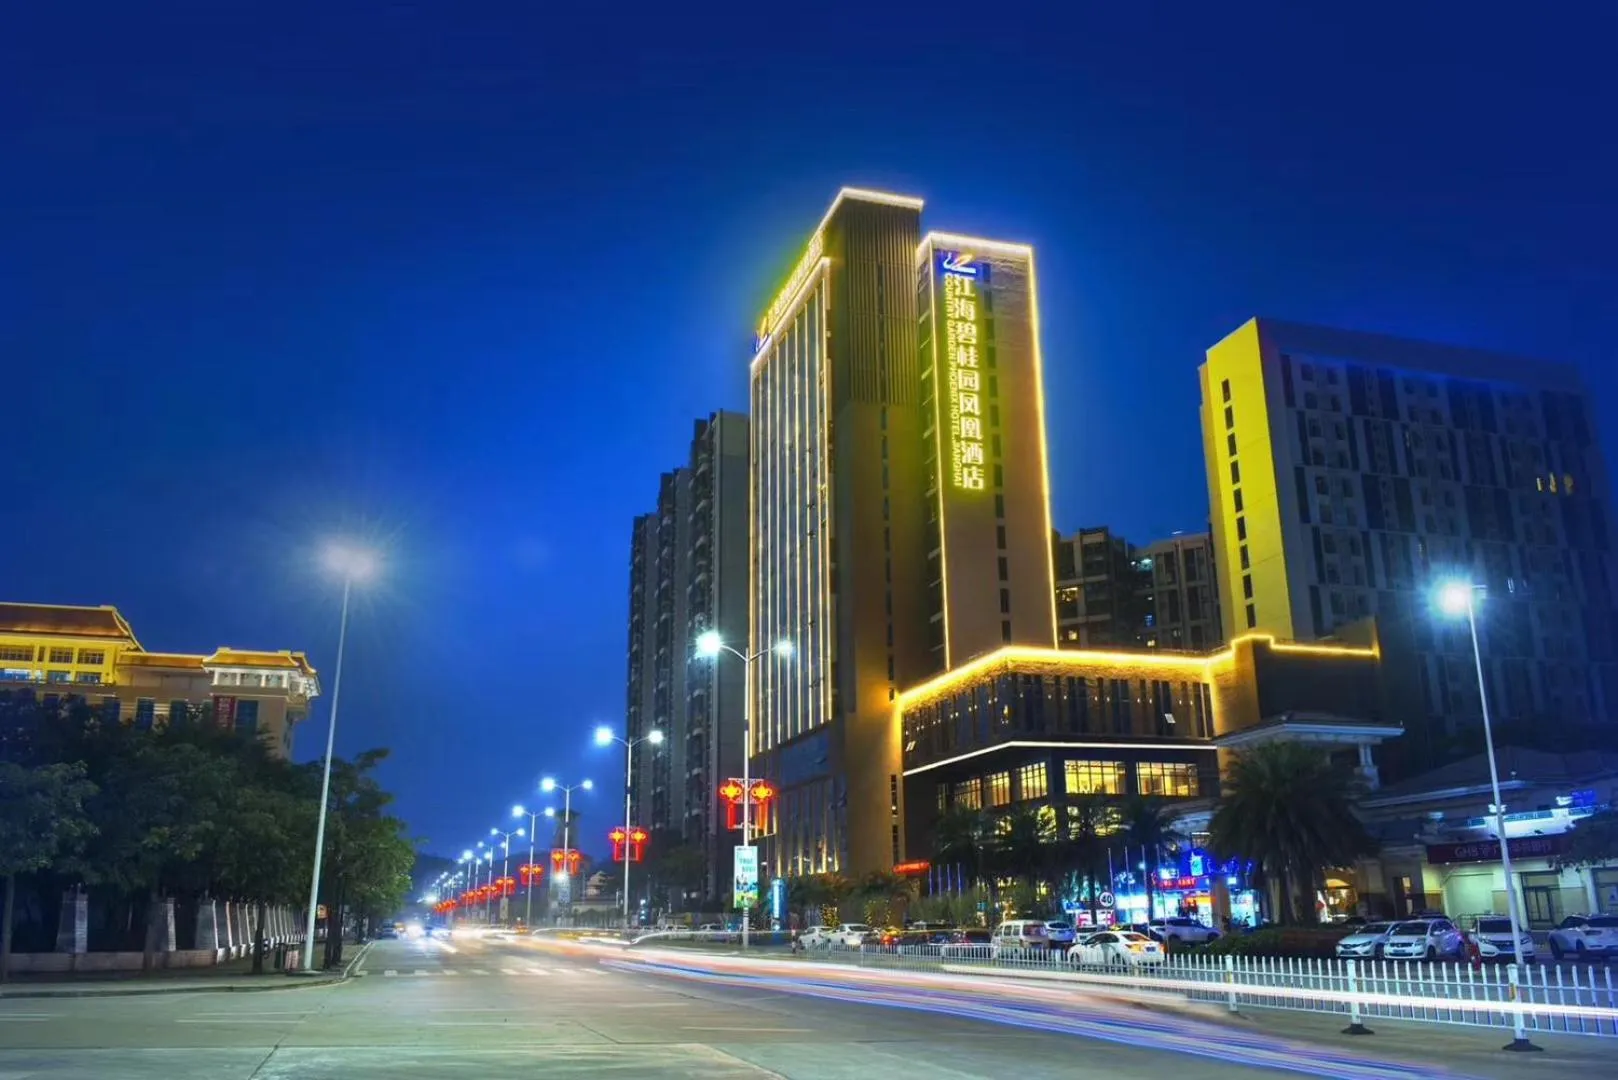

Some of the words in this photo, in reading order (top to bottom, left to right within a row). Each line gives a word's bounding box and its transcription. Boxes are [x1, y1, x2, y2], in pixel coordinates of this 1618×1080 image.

[945, 273, 955, 319] COUNTRY
[947, 320, 957, 361] GARDEN
[949, 361, 959, 403] PHOENIX
[953, 273, 984, 490] 江海碧桂园凤凰酒店
[1101, 895, 1112, 903] 40
